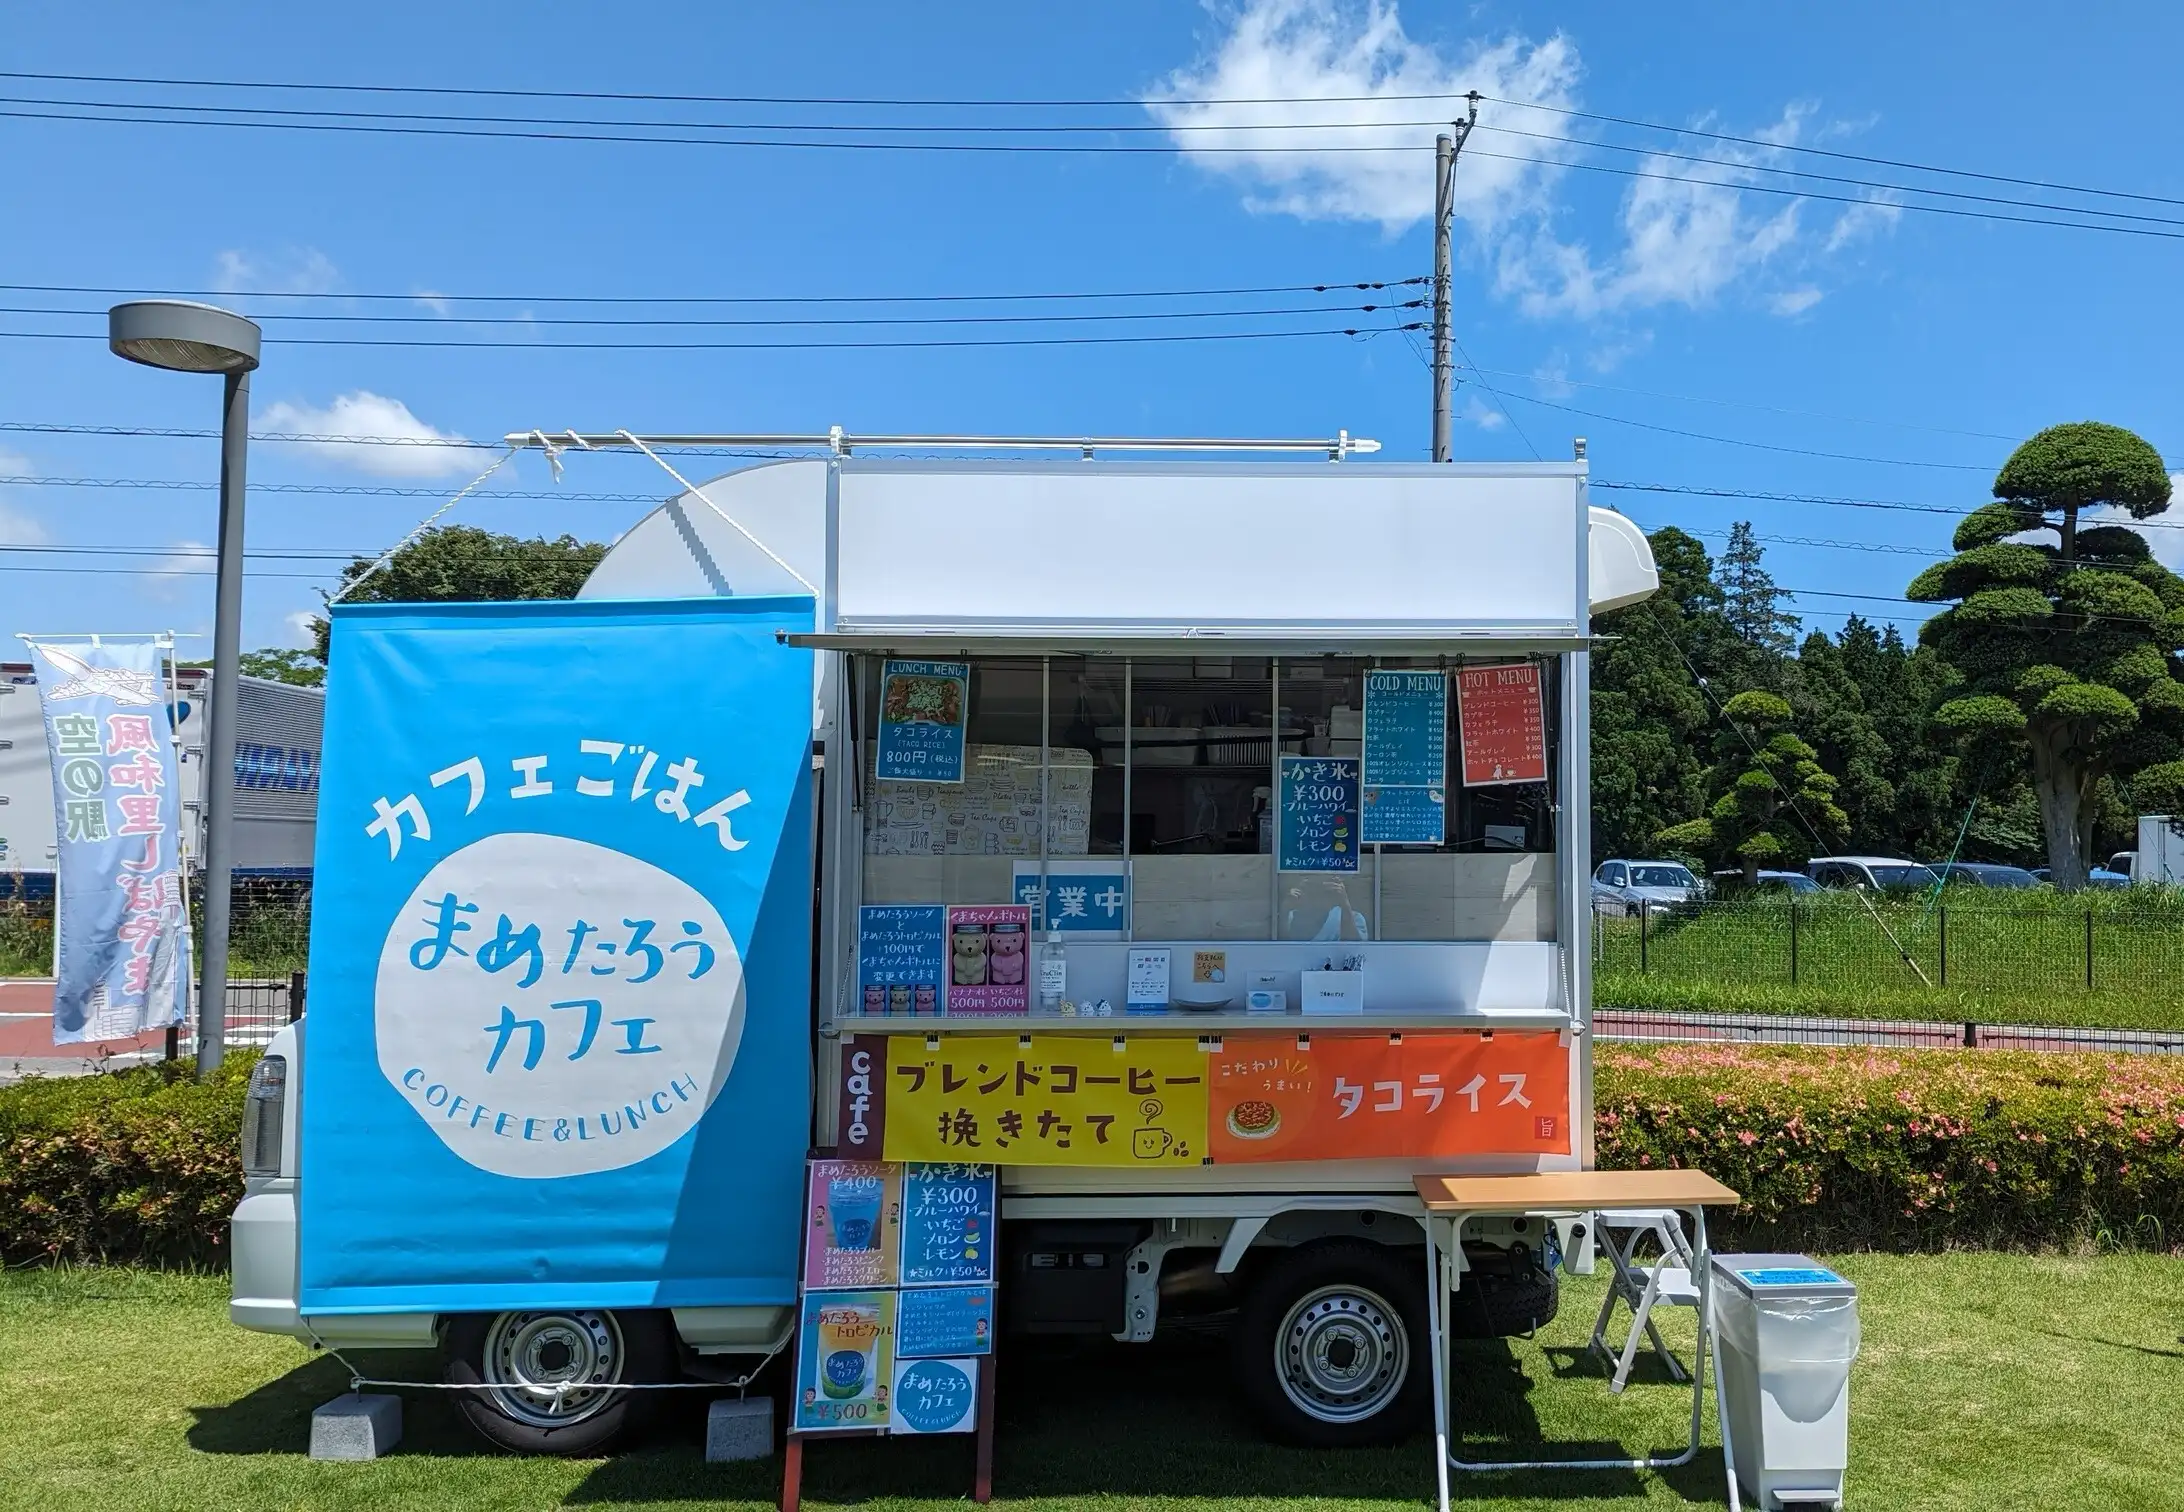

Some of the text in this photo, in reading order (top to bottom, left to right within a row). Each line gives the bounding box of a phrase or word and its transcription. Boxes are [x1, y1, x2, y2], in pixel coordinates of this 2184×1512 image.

[891, 662, 962, 678] LUNCH MENU
[1465, 669, 1533, 688] HOT MENU
[1370, 675, 1442, 691] COLD MENU
[893, 727, 954, 739] タコライス
[886, 751, 927, 764] 800円
[1291, 762, 1350, 782] かき氷
[365, 739, 752, 862] カフェごはん
[1293, 784, 1345, 801] ¥300
[1019, 884, 1124, 919] 営業中
[897, 920, 905, 931] と
[950, 909, 1028, 923] くまちゃんボトル
[409, 892, 716, 989] まめたろう
[951, 996, 1025, 1008] 500円 500円
[483, 999, 663, 1075] カフェ
[1222, 1057, 1279, 1077] こだわり
[896, 1060, 1201, 1097] ブレンドコーヒー
[403, 1067, 700, 1143] COFFEE&LUNCH
[847, 1050, 873, 1146] cafe
[1333, 1073, 1533, 1120] タコライス
[938, 1107, 1116, 1150] 挽きたて
[1540, 1117, 1554, 1138] 旨
[818, 1163, 897, 1178] まめたろうソーダ
[919, 1163, 983, 1184] かき氷
[832, 1175, 877, 1190] ¥400
[921, 1186, 977, 1205] ¥300
[805, 1311, 861, 1326] まめたろう
[837, 1324, 893, 1338] トロピカル
[904, 1372, 967, 1393] まめたろう
[818, 1403, 867, 1421] ¥500
[918, 1394, 955, 1411] カフェ
